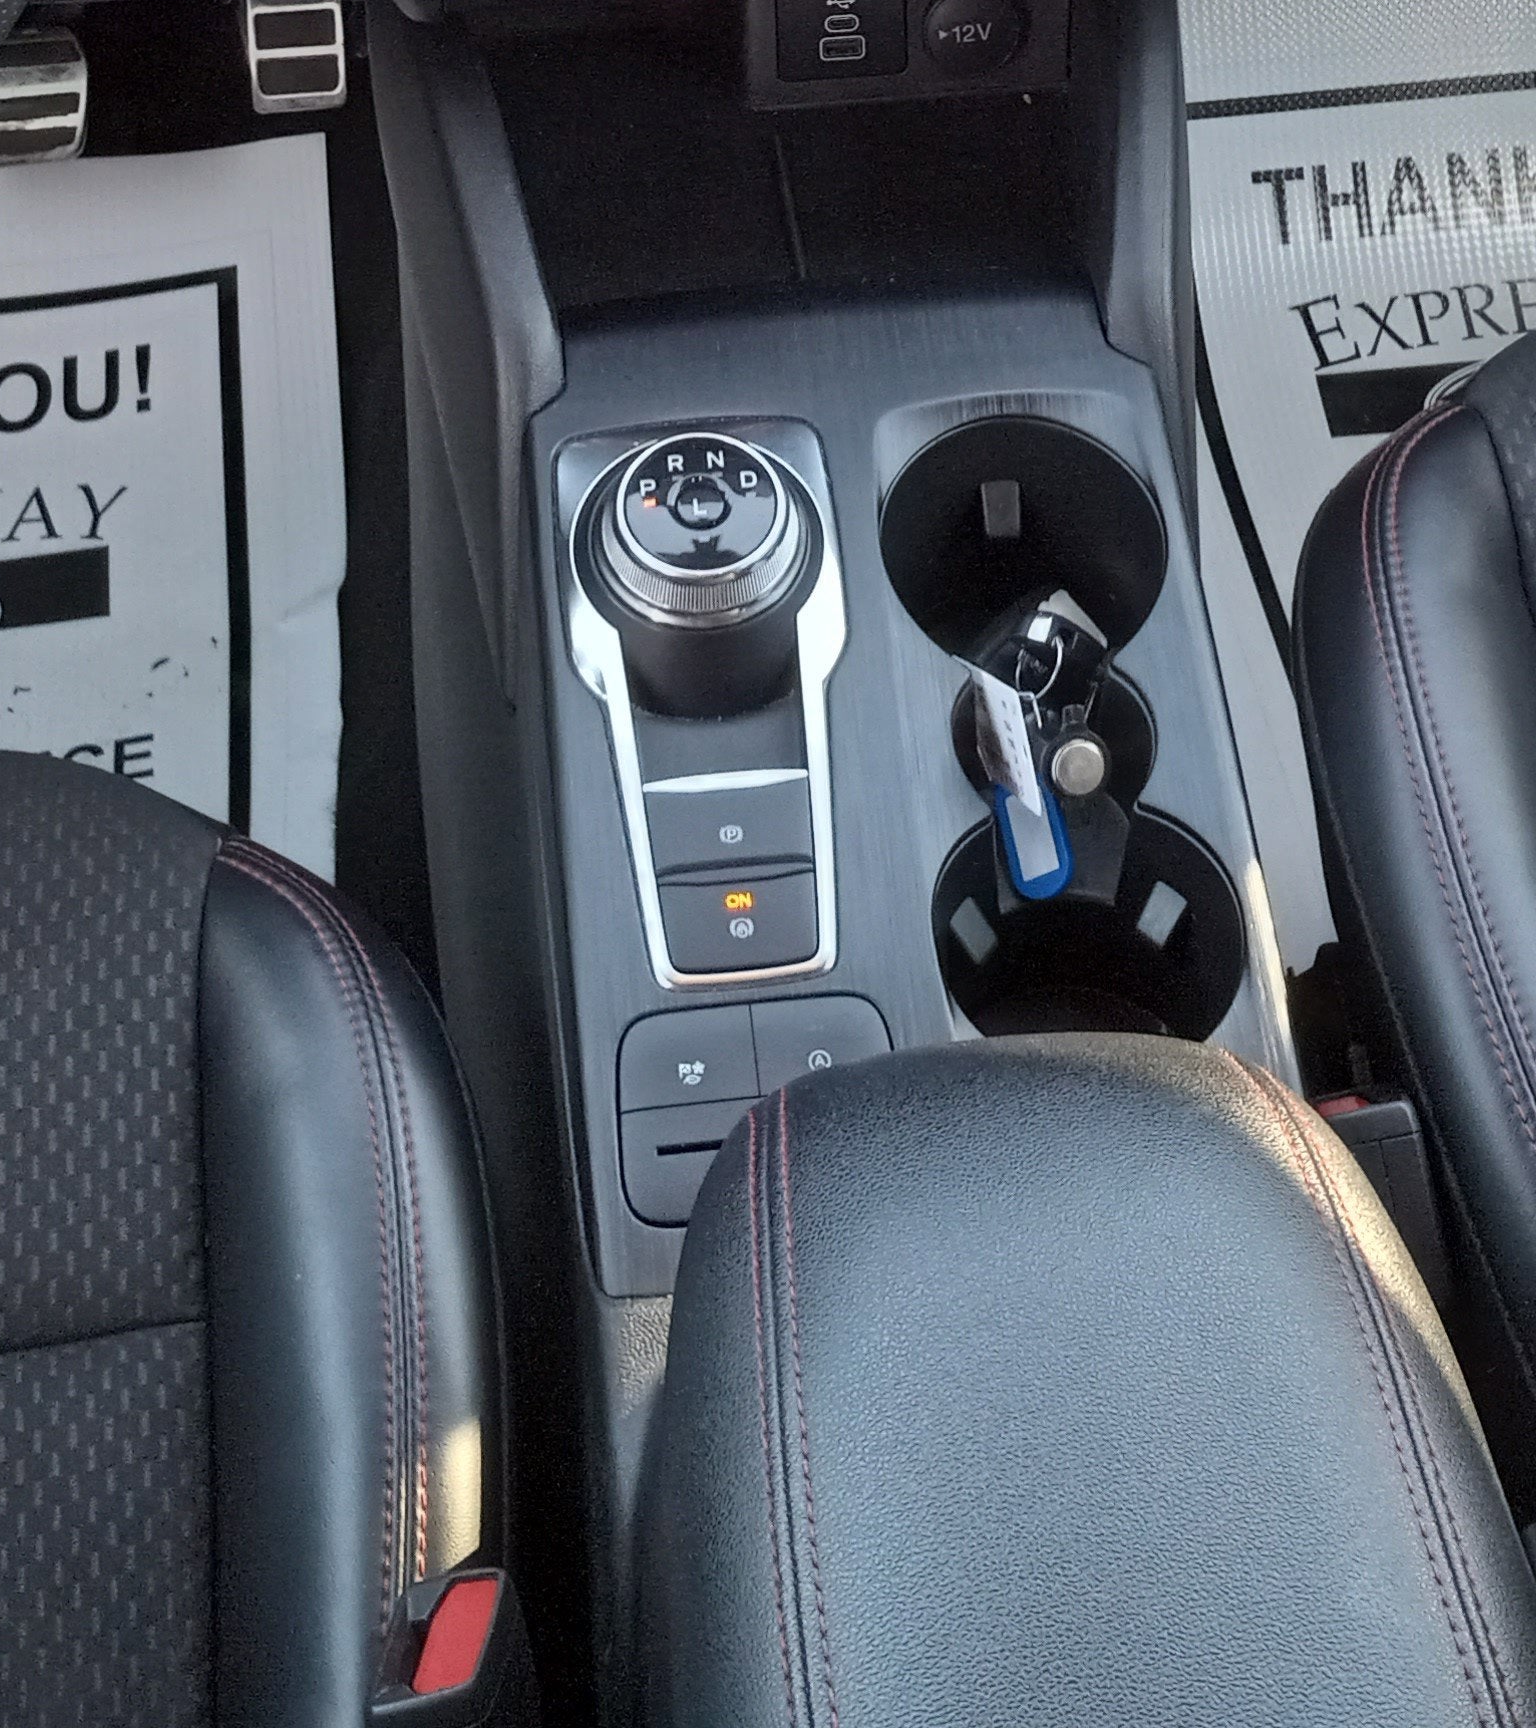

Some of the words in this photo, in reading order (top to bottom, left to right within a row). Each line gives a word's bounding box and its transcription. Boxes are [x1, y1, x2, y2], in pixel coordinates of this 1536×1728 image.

[950, 21, 993, 44] 12V
[667, 453, 684, 473] R
[705, 449, 726, 469] N
[638, 478, 657, 497] P
[739, 470, 759, 489] D
[692, 497, 708, 516] L
[725, 892, 753, 909] ON
